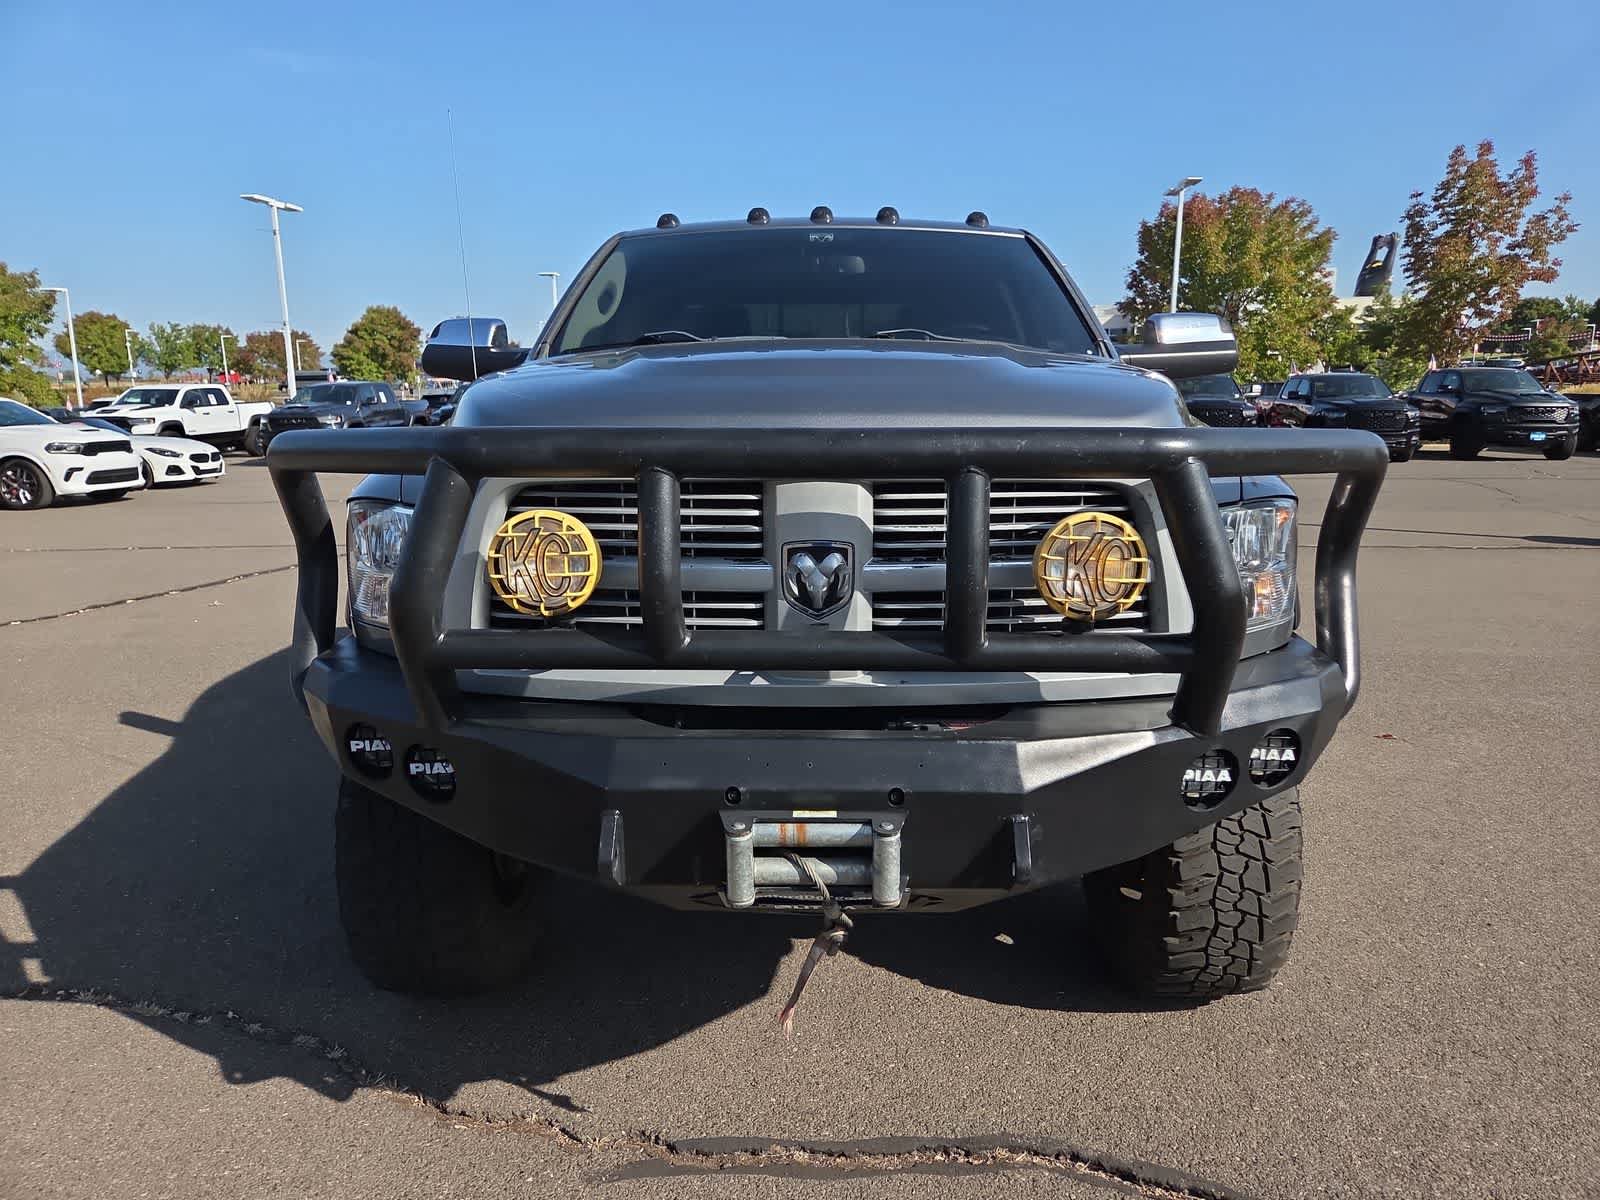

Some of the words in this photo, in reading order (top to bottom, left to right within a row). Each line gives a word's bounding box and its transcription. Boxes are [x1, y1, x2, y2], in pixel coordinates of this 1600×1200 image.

[504, 527, 572, 602] KC
[1063, 531, 1132, 607] KC
[1182, 768, 1232, 782] PIAA
[1250, 747, 1296, 760] PIAA
